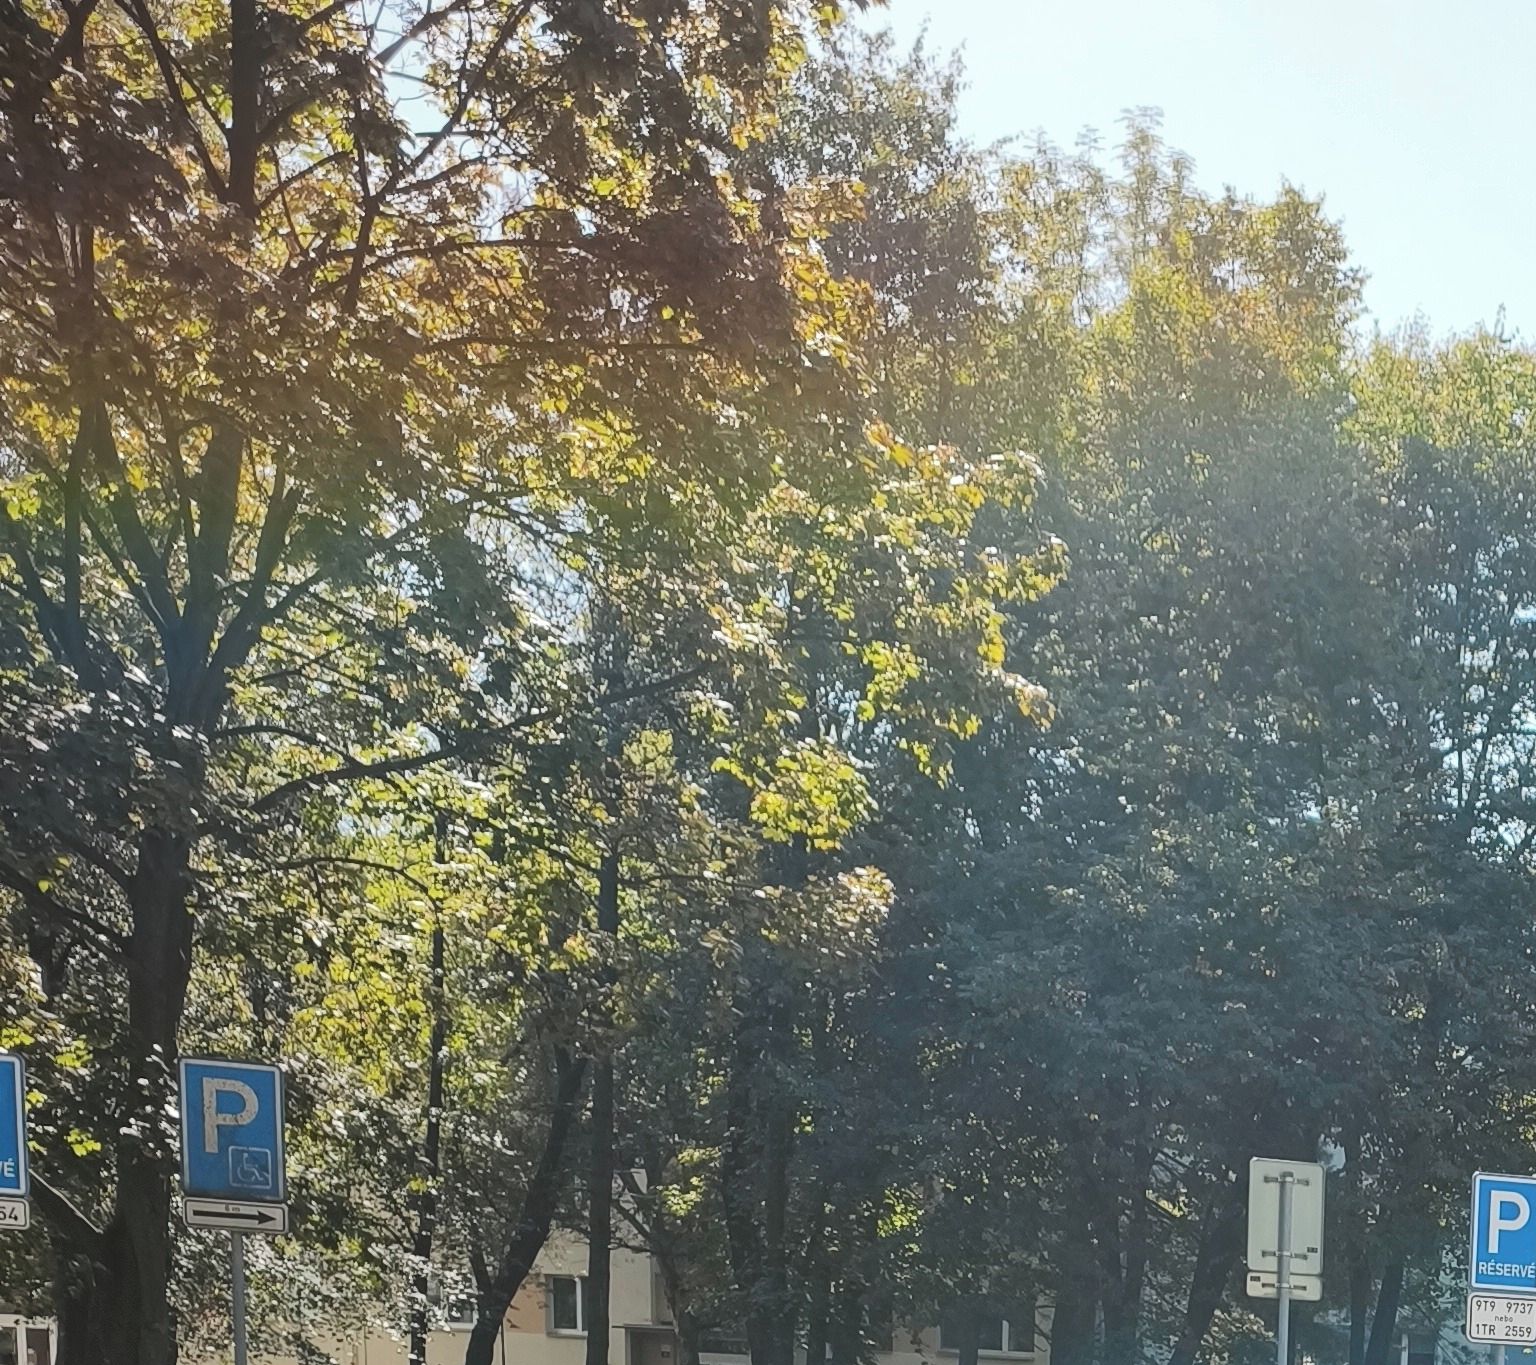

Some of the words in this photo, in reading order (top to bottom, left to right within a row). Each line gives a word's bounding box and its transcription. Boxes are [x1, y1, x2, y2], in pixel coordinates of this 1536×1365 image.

[203, 1077, 258, 1153] P
[1488, 1190, 1530, 1253] P
[1478, 1259, 1536, 1278] RÉSERVÉ
[1476, 1300, 1495, 1312] 9T9
[1506, 1302, 1533, 1314] 9737
[1476, 1324, 1495, 1336] 1TR
[1505, 1326, 1532, 1338] 2559
